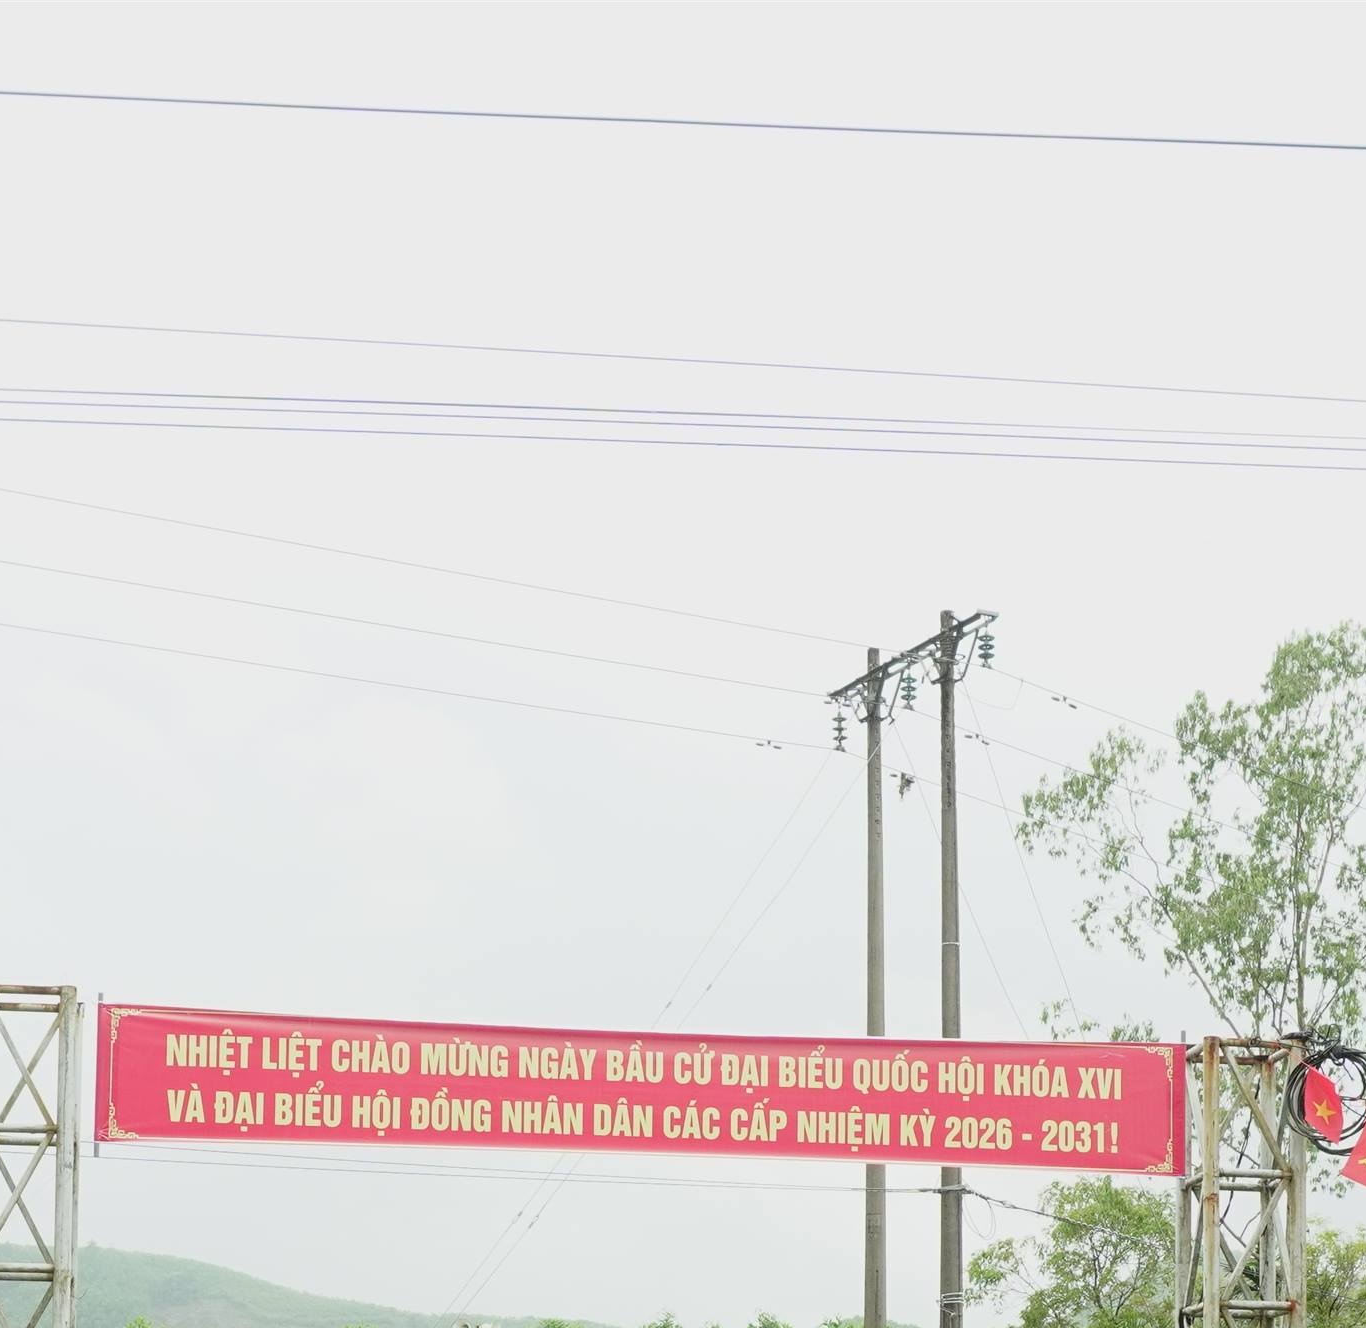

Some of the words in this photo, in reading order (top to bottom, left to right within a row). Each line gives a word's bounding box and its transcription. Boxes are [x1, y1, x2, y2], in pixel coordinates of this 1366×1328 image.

[166, 1028, 253, 1075] NHIỆT
[263, 1031, 322, 1078] LIỆT
[331, 1034, 411, 1074] CHÀO
[420, 1037, 509, 1078] MỪNG
[518, 1040, 596, 1081] NGÀY
[606, 1040, 664, 1083] BẦU
[673, 1043, 716, 1085] CỬ
[720, 1054, 769, 1094] ĐẠI
[778, 1045, 843, 1090] BIỂU
[853, 1049, 929, 1095] QUỐC
[938, 1055, 985, 1102] HỘI
[994, 1059, 1070, 1099] KHÓA
[1077, 1067, 1122, 1100] XVI
[166, 1083, 205, 1124] VÀ
[213, 1091, 264, 1132] ĐẠI
[274, 1080, 342, 1128] BIỂU
[351, 1089, 401, 1136] HỘI
[410, 1087, 492, 1132] ĐỒNG
[501, 1095, 584, 1136] NHÂN
[593, 1097, 653, 1137] DÂN
[662, 1100, 720, 1140] CÁC
[730, 1097, 788, 1142] CẤP
[797, 1105, 891, 1152] NHIỆM
[899, 1108, 937, 1148] KỲ
[944, 1116, 1013, 1150] 2026
[1021, 1133, 1033, 1141] -
[1041, 1119, 1119, 1154] 2031!
